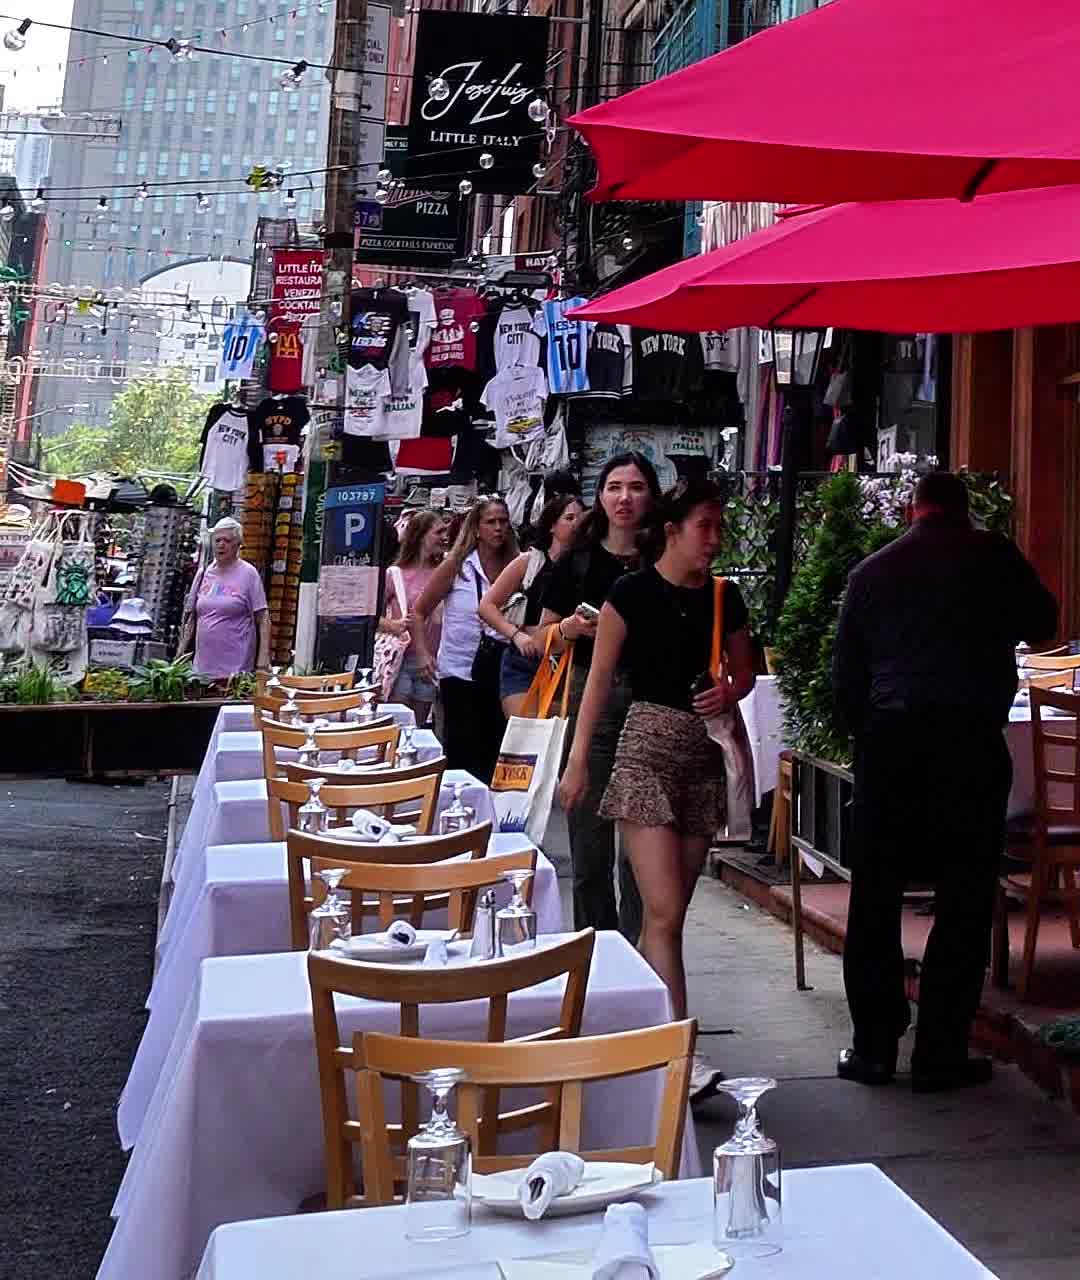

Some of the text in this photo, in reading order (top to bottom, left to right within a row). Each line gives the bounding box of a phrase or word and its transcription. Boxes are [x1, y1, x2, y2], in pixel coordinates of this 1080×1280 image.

[430, 130, 522, 148] LITTLE ITALY
[415, 200, 449, 216] PIZZA
[361, 238, 455, 251] PIZZA COCKTAILS ESPRESSO
[278, 263, 309, 274] LITTLE
[278, 300, 321, 310] COCKTAIL
[507, 332, 524, 345] CITY
[596, 331, 621, 354] YORK
[640, 333, 686, 357] NEW YORK
[227, 335, 248, 361] 10
[553, 333, 581, 370] 10
[337, 490, 377, 501] 103787
[344, 512, 366, 547] P
